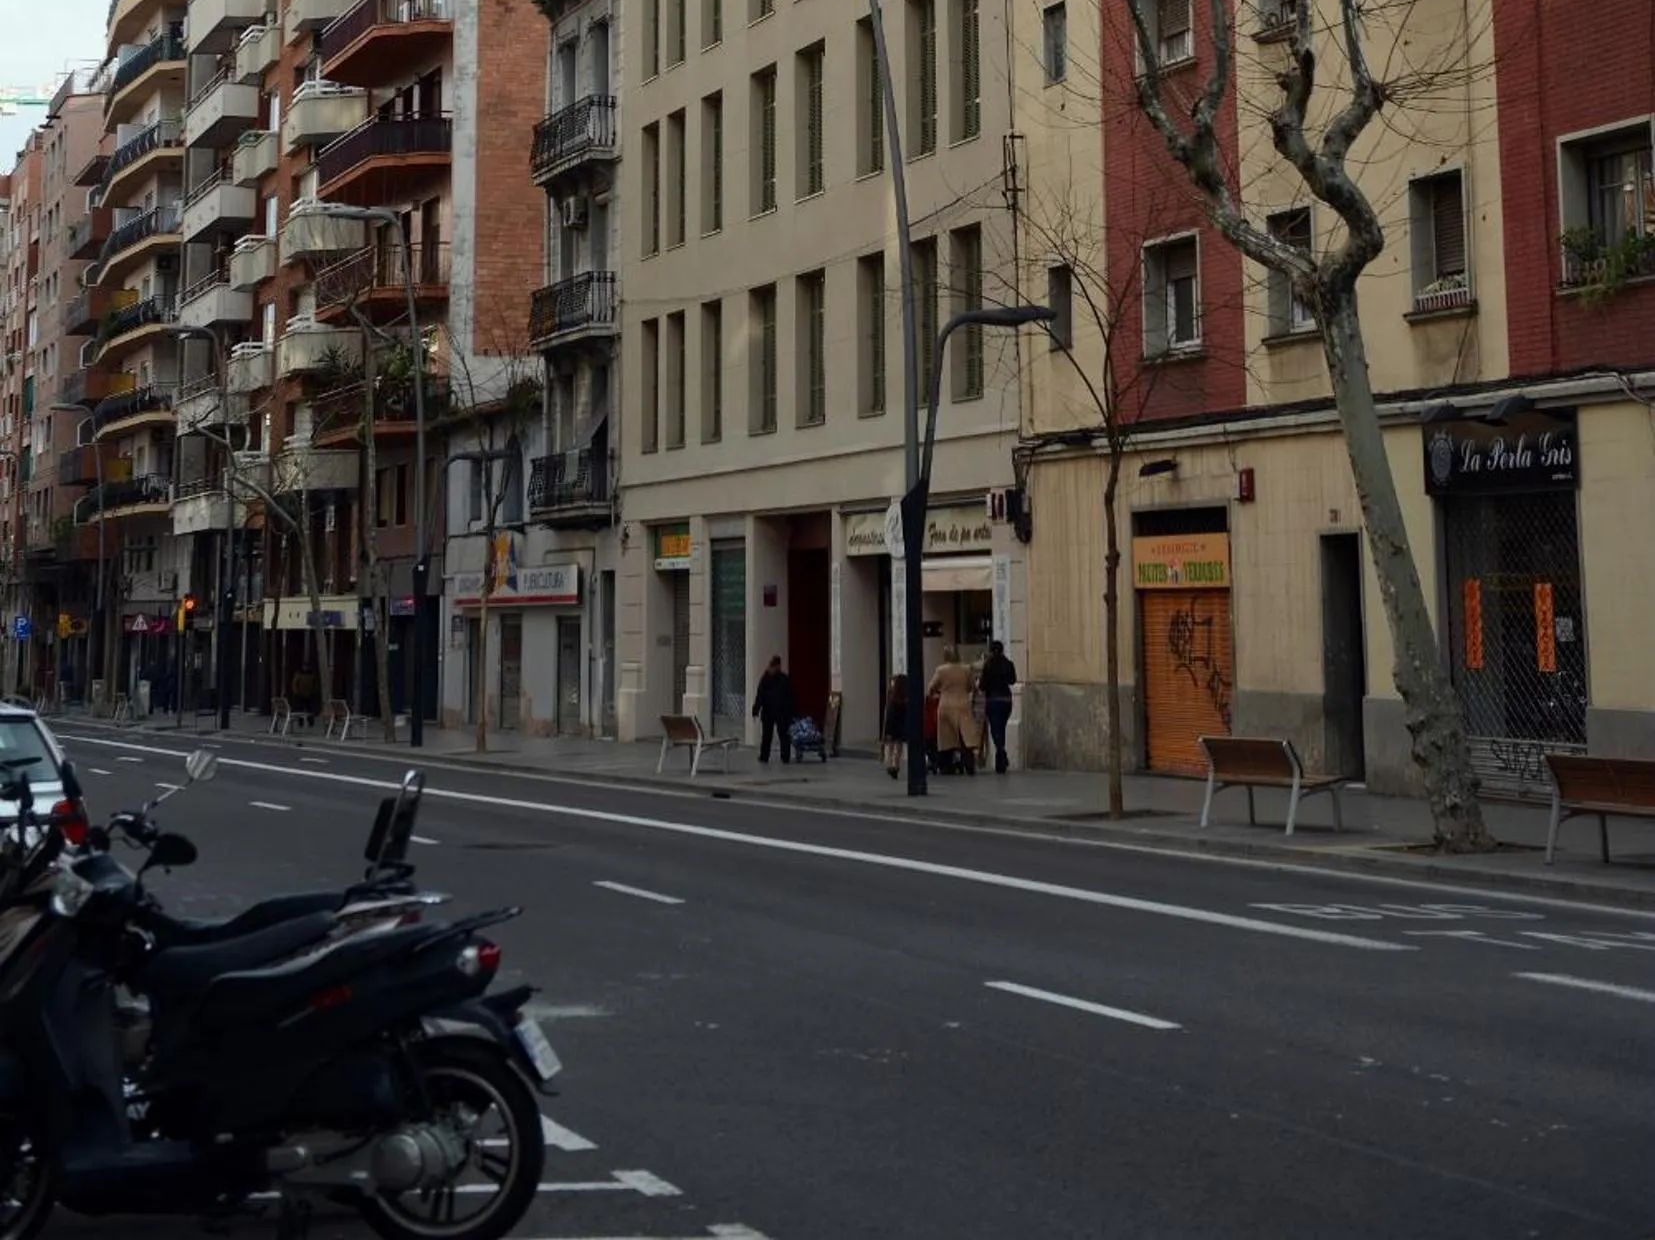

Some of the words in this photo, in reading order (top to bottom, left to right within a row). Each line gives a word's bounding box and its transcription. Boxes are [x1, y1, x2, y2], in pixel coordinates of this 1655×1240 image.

[1459, 439, 1480, 473] La
[1487, 436, 1532, 471] Perla
[1539, 431, 1573, 467] Gris
[1246, 902, 1547, 921] BUS
